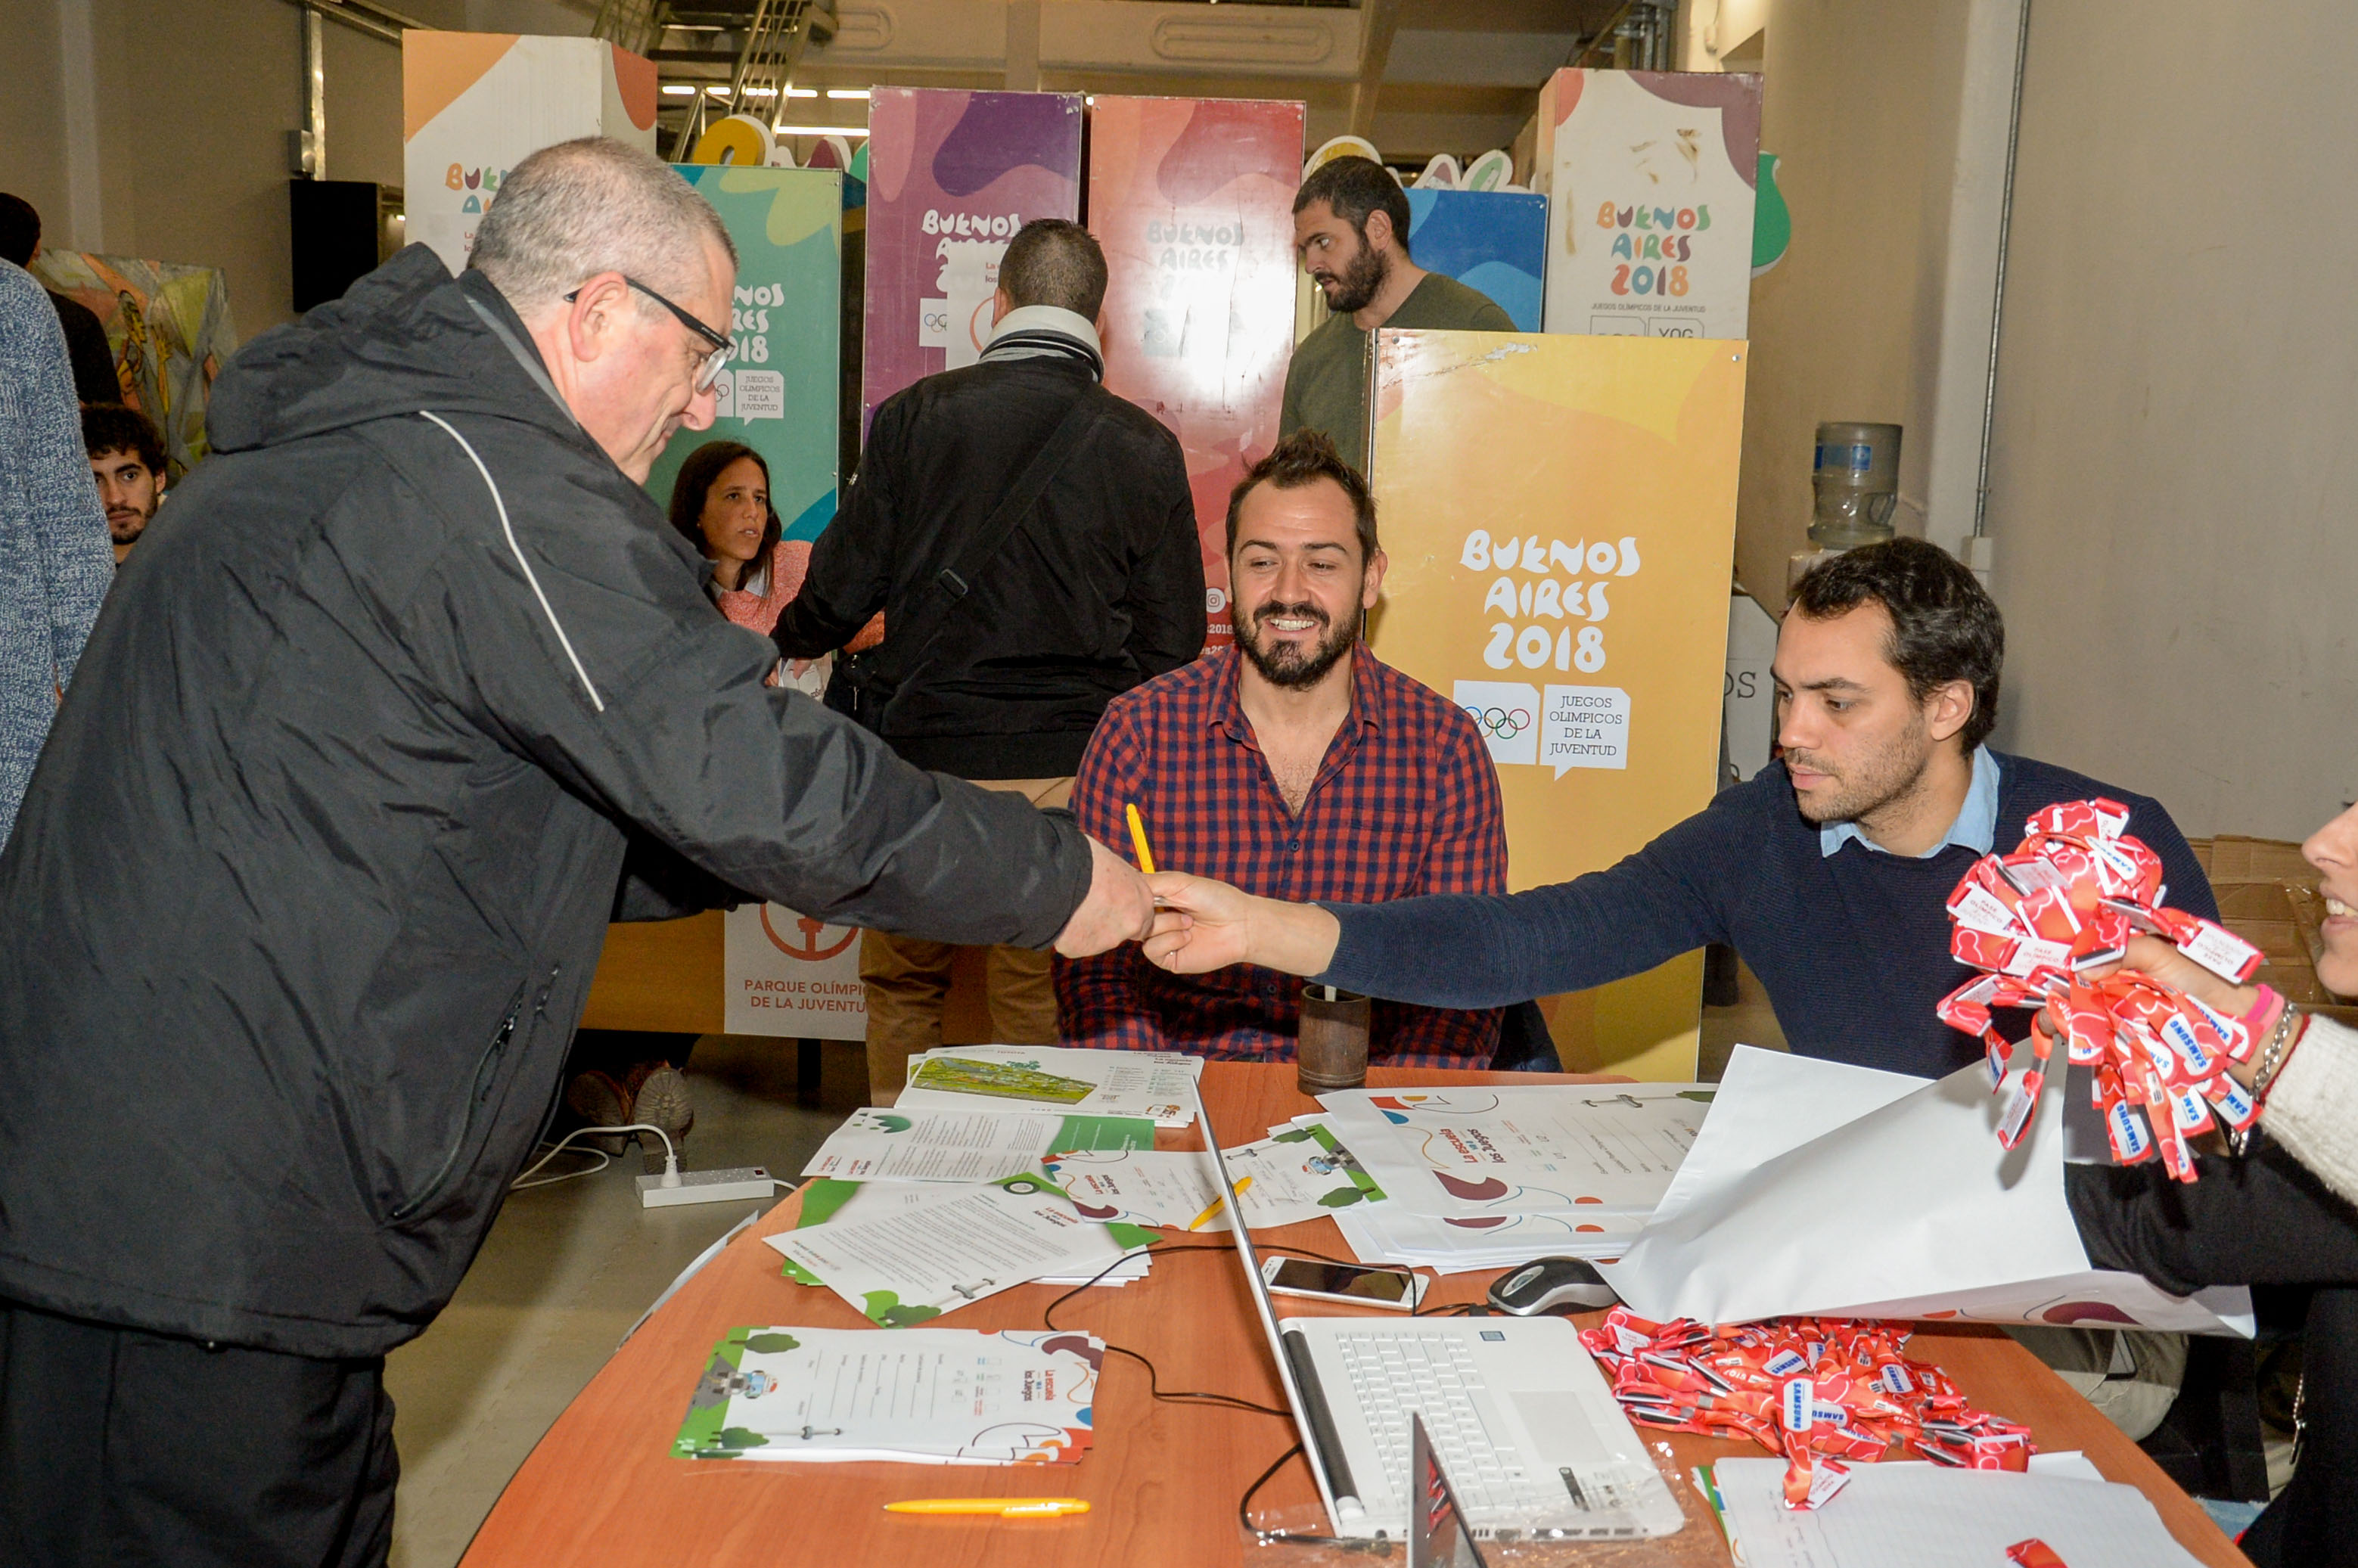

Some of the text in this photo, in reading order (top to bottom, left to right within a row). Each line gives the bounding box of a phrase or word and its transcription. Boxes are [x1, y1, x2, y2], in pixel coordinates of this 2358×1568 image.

[921, 209, 1022, 238] BUENOS
[1597, 200, 1711, 231] BUENOS
[1147, 219, 1245, 246] BUENOS
[1611, 233, 1692, 262] AIRES
[1611, 263, 1689, 297] 2018
[733, 283, 785, 307] NOS
[1592, 303, 1617, 311] JUEGOS
[745, 375, 774, 384] JUEGOS
[741, 403, 778, 411] JUVENTUD
[1459, 529, 1641, 577] BUENOS
[1484, 576, 1610, 622] AIRES
[1207, 624, 1234, 634] 2018
[1483, 623, 1606, 673] 2018
[1560, 696, 1612, 708] JUEGOS
[1549, 711, 1623, 725] OLIMPICOS
[1564, 728, 1602, 739] DE LA
[1549, 743, 1617, 756] JUVENTUD
[744, 980, 806, 993] PARQUE
[750, 996, 770, 1008] DE
[775, 997, 793, 1009] LA
[2170, 1020, 2207, 1068] SAMSUNG
[2117, 1104, 2141, 1153] SAMSUNG
[1440, 1129, 1479, 1163] La escuela
[1467, 1129, 1508, 1163] los Juegos
[1021, 1370, 1036, 1401] los Juegos
[1045, 1377, 1057, 1401] escuela
[1793, 1382, 1802, 1429] SAMSUNG
